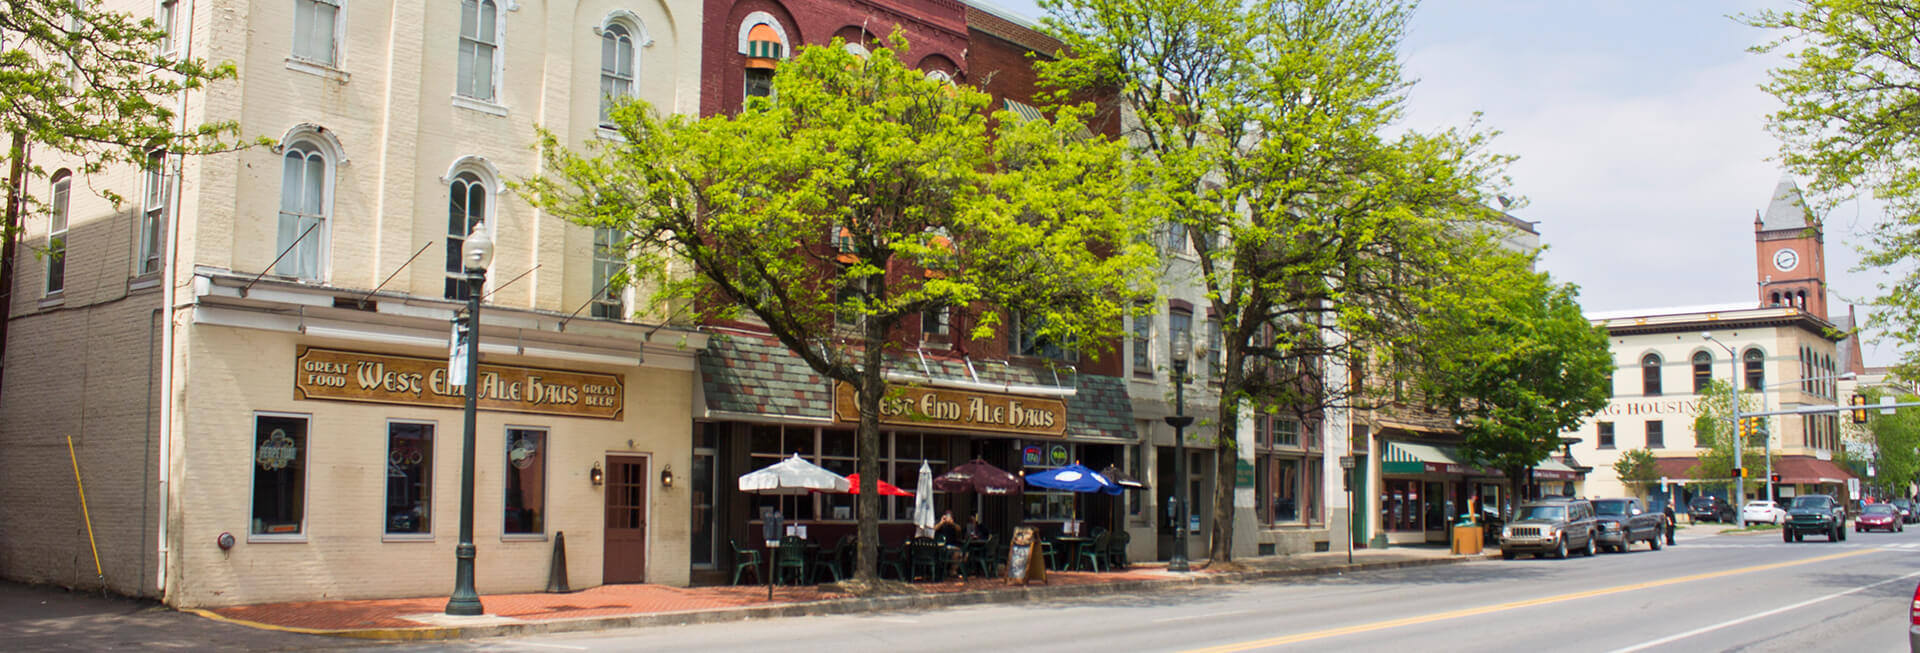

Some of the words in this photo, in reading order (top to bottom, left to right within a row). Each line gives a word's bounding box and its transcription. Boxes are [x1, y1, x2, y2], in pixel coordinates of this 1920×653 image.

[304, 360, 349, 374] GREAT
[308, 374, 346, 387] FOOD
[582, 383, 616, 396] GREAT
[585, 395, 614, 407] BEER
[854, 390, 915, 416] EST
